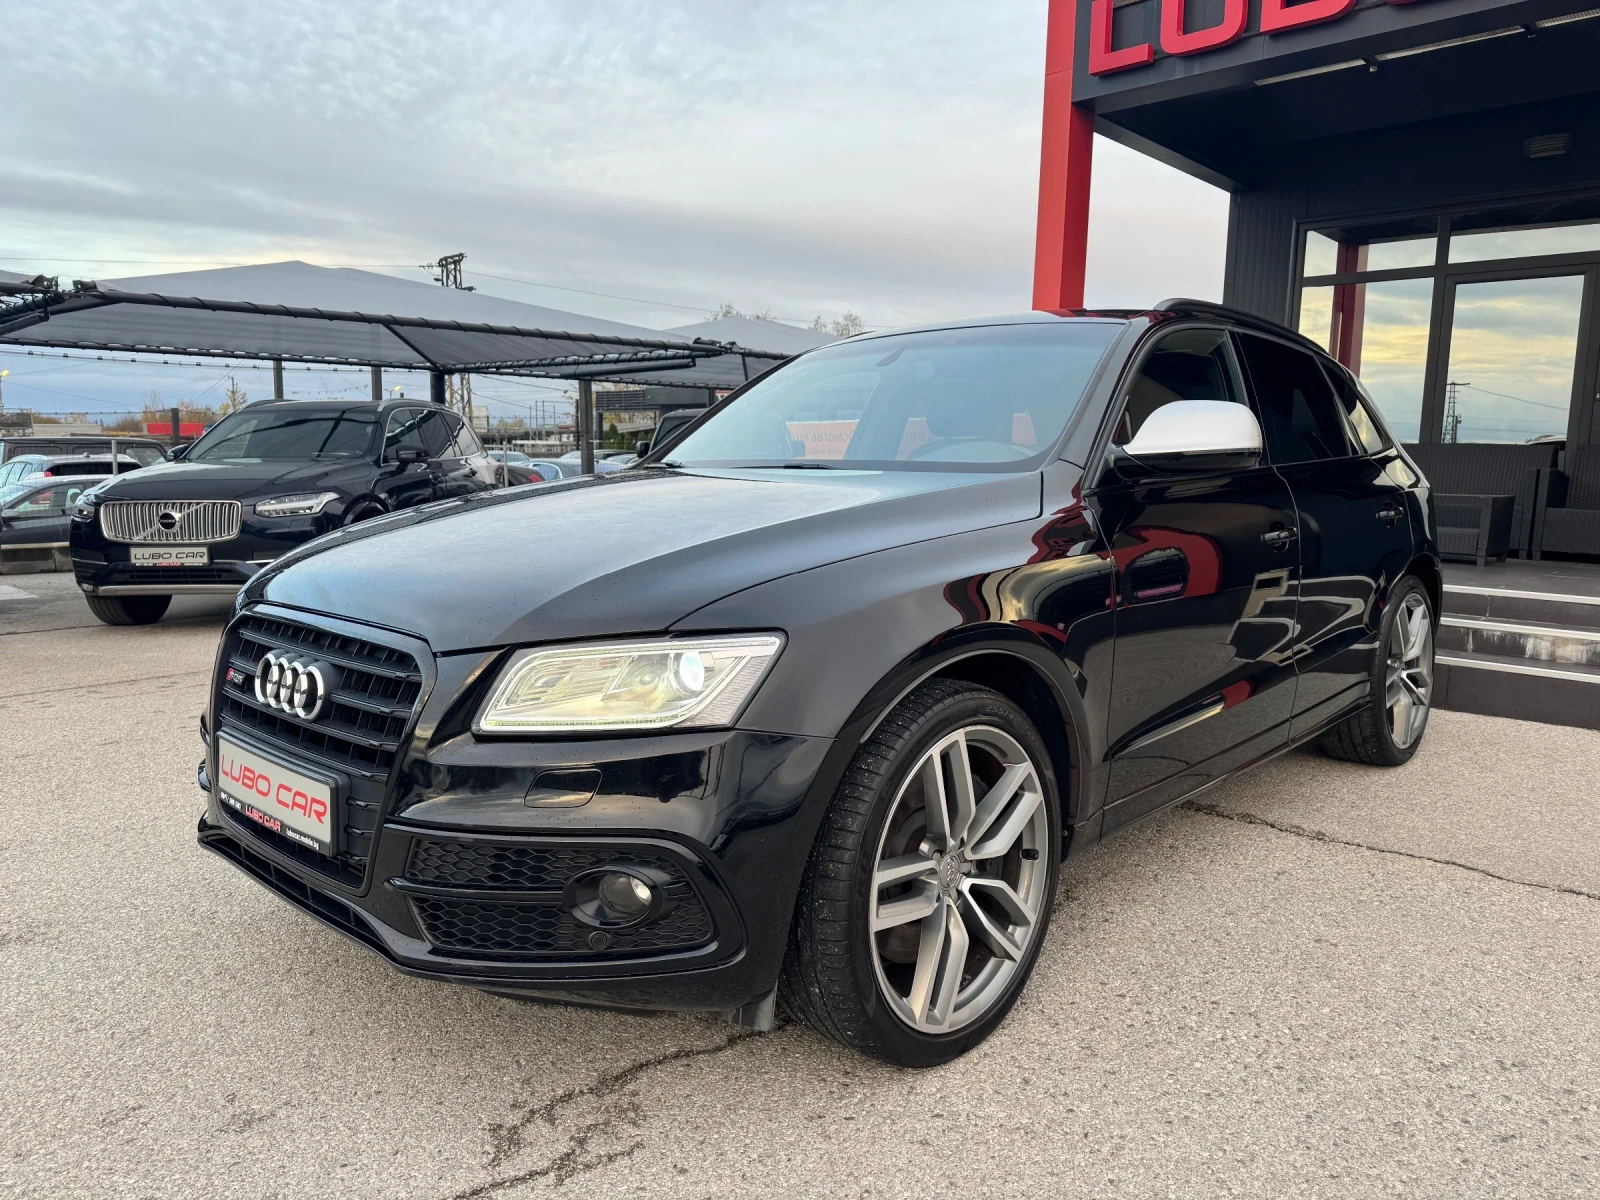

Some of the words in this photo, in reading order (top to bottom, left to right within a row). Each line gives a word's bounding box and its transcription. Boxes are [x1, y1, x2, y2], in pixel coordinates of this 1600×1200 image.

[811, 431, 855, 442] автомоб
[134, 552, 172, 560] LUBO
[175, 551, 206, 560] CAR
[220, 753, 271, 798] LUBO
[275, 783, 328, 825] CAR
[245, 804, 264, 824] LUBO
[264, 815, 281, 833] CAR
